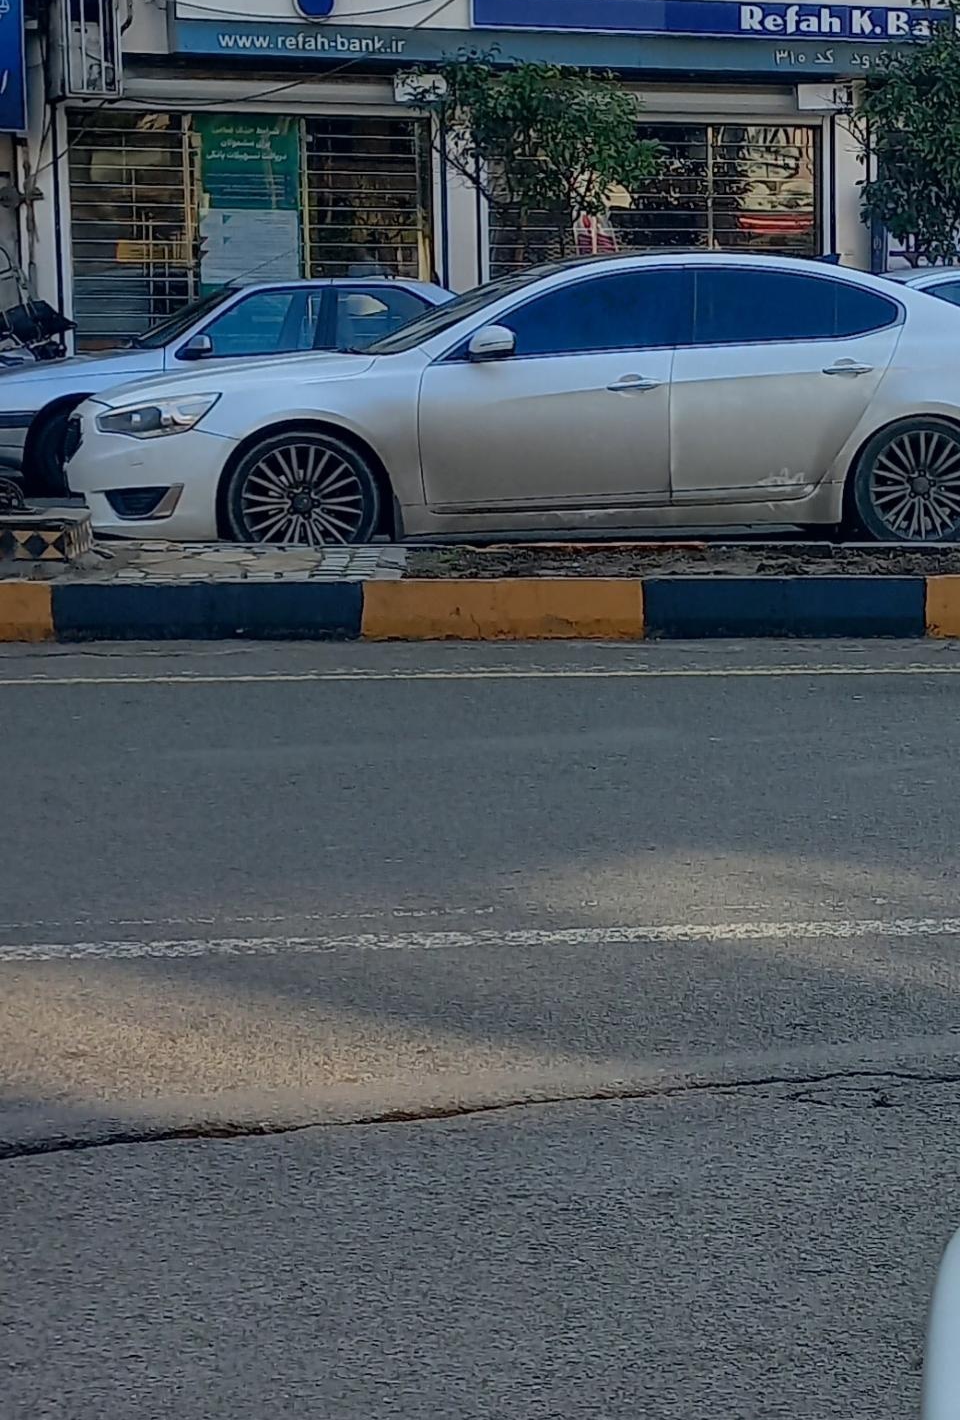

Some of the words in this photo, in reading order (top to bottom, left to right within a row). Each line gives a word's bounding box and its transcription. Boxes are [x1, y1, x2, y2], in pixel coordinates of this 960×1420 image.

[741, 5, 841, 35] Refah
[218, 33, 405, 53] www.refah-bank.ir
[775, 50, 806, 65] ۳۱۰
[814, 49, 834, 64] کد
